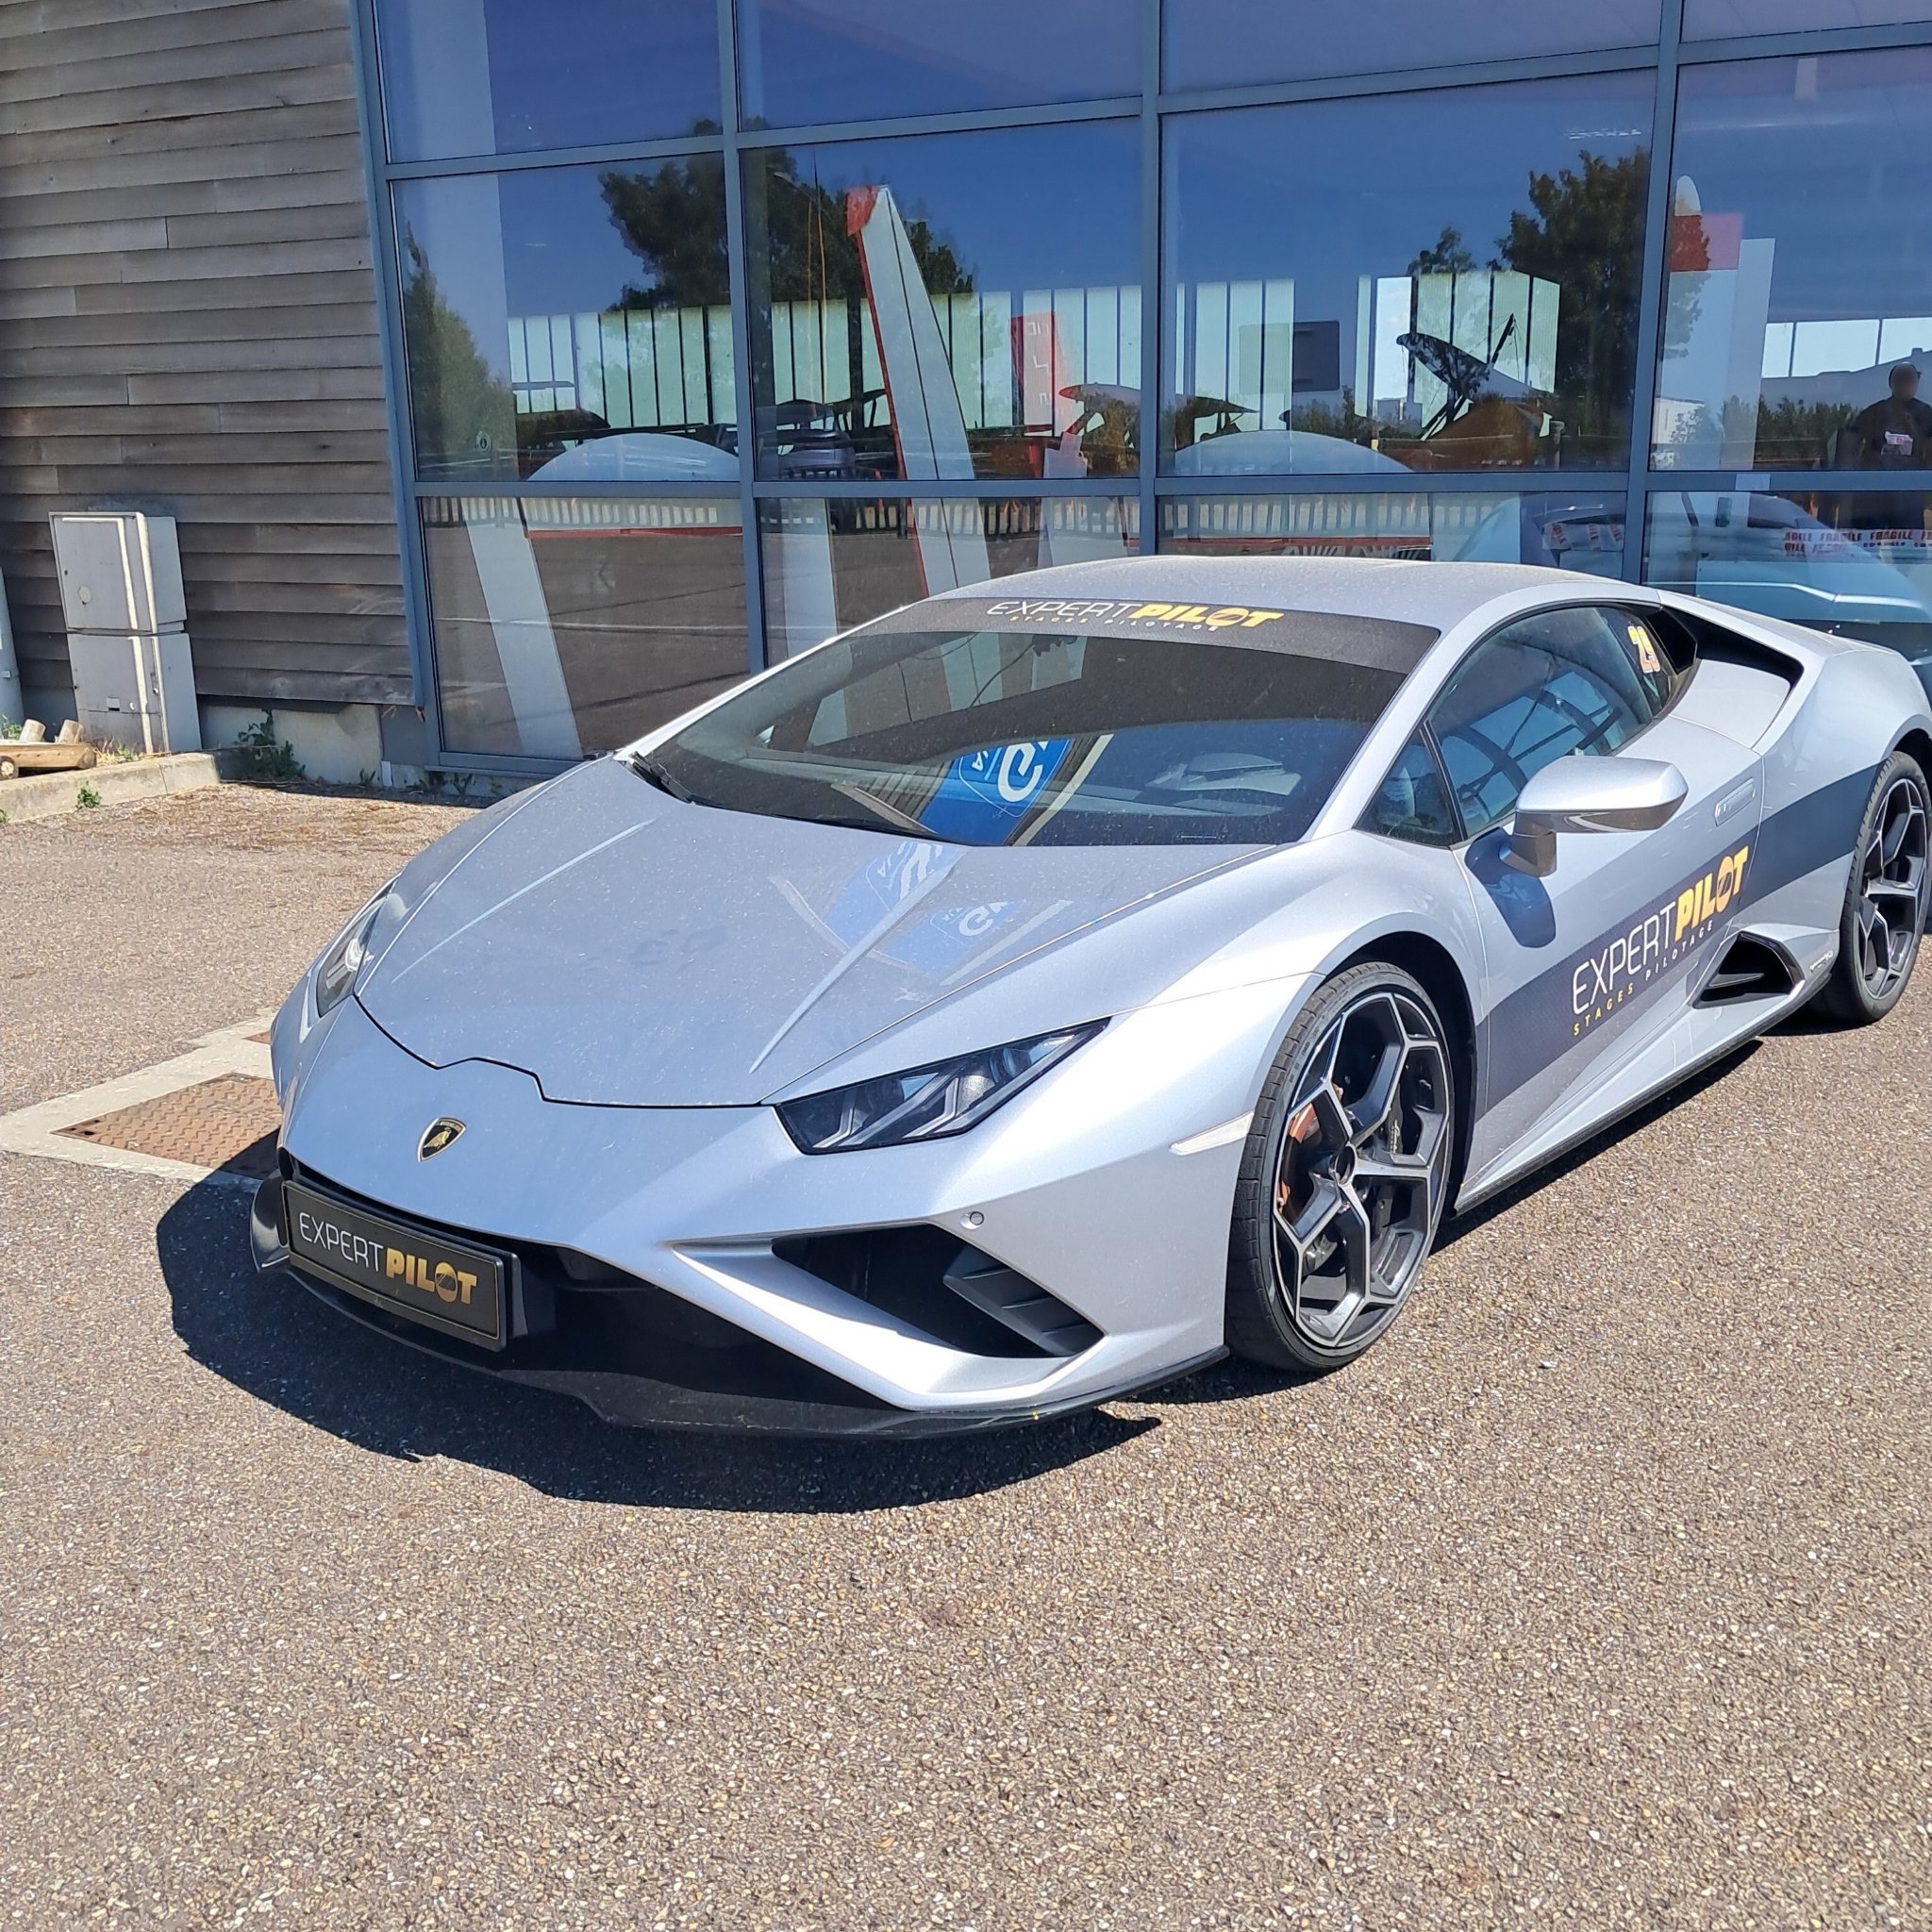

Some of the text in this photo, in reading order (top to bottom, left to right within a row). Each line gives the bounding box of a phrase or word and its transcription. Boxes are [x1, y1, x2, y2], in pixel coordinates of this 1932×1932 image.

[1871, 531, 1913, 541] FRAGILE
[1009, 615, 1220, 632] STAGES PILOTAGE
[1573, 920, 1713, 1036] STAGES PILOTAGE
